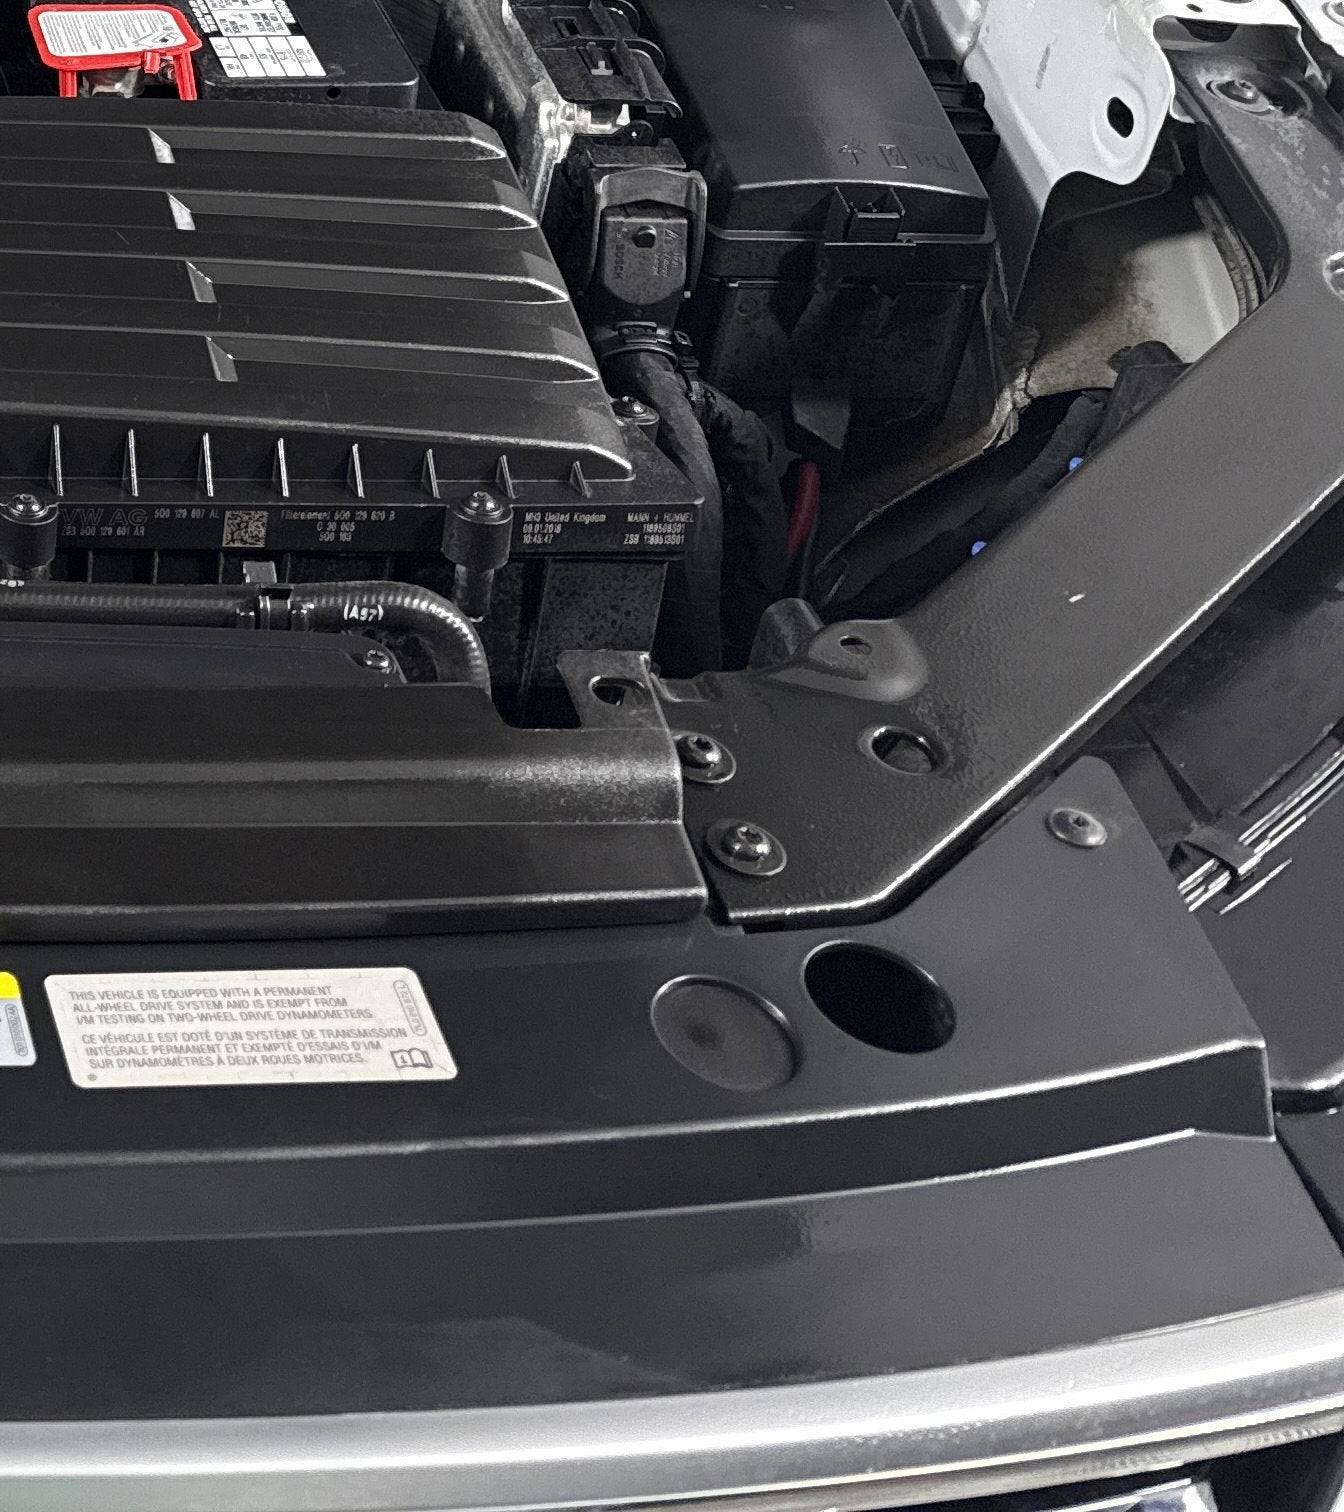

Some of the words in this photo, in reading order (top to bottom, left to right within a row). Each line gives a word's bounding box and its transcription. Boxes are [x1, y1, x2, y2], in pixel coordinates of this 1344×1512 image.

[109, 509, 147, 525] AG
[545, 513, 569, 522] United
[573, 513, 606, 524] Kingdom
[627, 513, 649, 522] MANN
[69, 991, 95, 1000] THIS
[97, 990, 144, 1000] VEHICLE
[148, 989, 159, 998] IS
[162, 989, 217, 998] EQUIPPED
[220, 988, 250, 997] WITH
[263, 986, 331, 996] PERMANENT
[73, 1002, 136, 1012] ALL-WHEEL
[140, 1001, 174, 1011] DRIVE
[177, 1001, 223, 1010] SYSTEM
[226, 1000, 249, 1009] AND
[253, 999, 264, 1008] IS
[266, 998, 311, 1008] EXEMPT
[314, 998, 347, 1007] FROM
[98, 1014, 144, 1024] TESTING
[148, 1013, 164, 1023] ON
[168, 1012, 237, 1022] TWO-WHEEL
[240, 1011, 274, 1021] DRIVE
[82, 1034, 96, 1044] CE
[100, 1032, 154, 1043] VÉHICULE
[159, 1033, 178, 1043] EST
[182, 1030, 211, 1042] DOTÉ
[214, 1032, 243, 1041] D'UN
[302, 1030, 317, 1039] DE
[321, 1028, 406, 1038] TRANSMISSION
[86, 1044, 149, 1056] INTÉGRALE
[152, 1044, 221, 1055] PERMANENT
[225, 1044, 239, 1052] ET
[242, 1040, 295, 1052] EXEMPTÉ
[297, 1042, 349, 1051] D'ESSAIS
[89, 1059, 113, 1069] SUR
[227, 1056, 259, 1065] DEUX
[262, 1055, 301, 1064] ROUES
[304, 1053, 366, 1064] MOTRICES.
